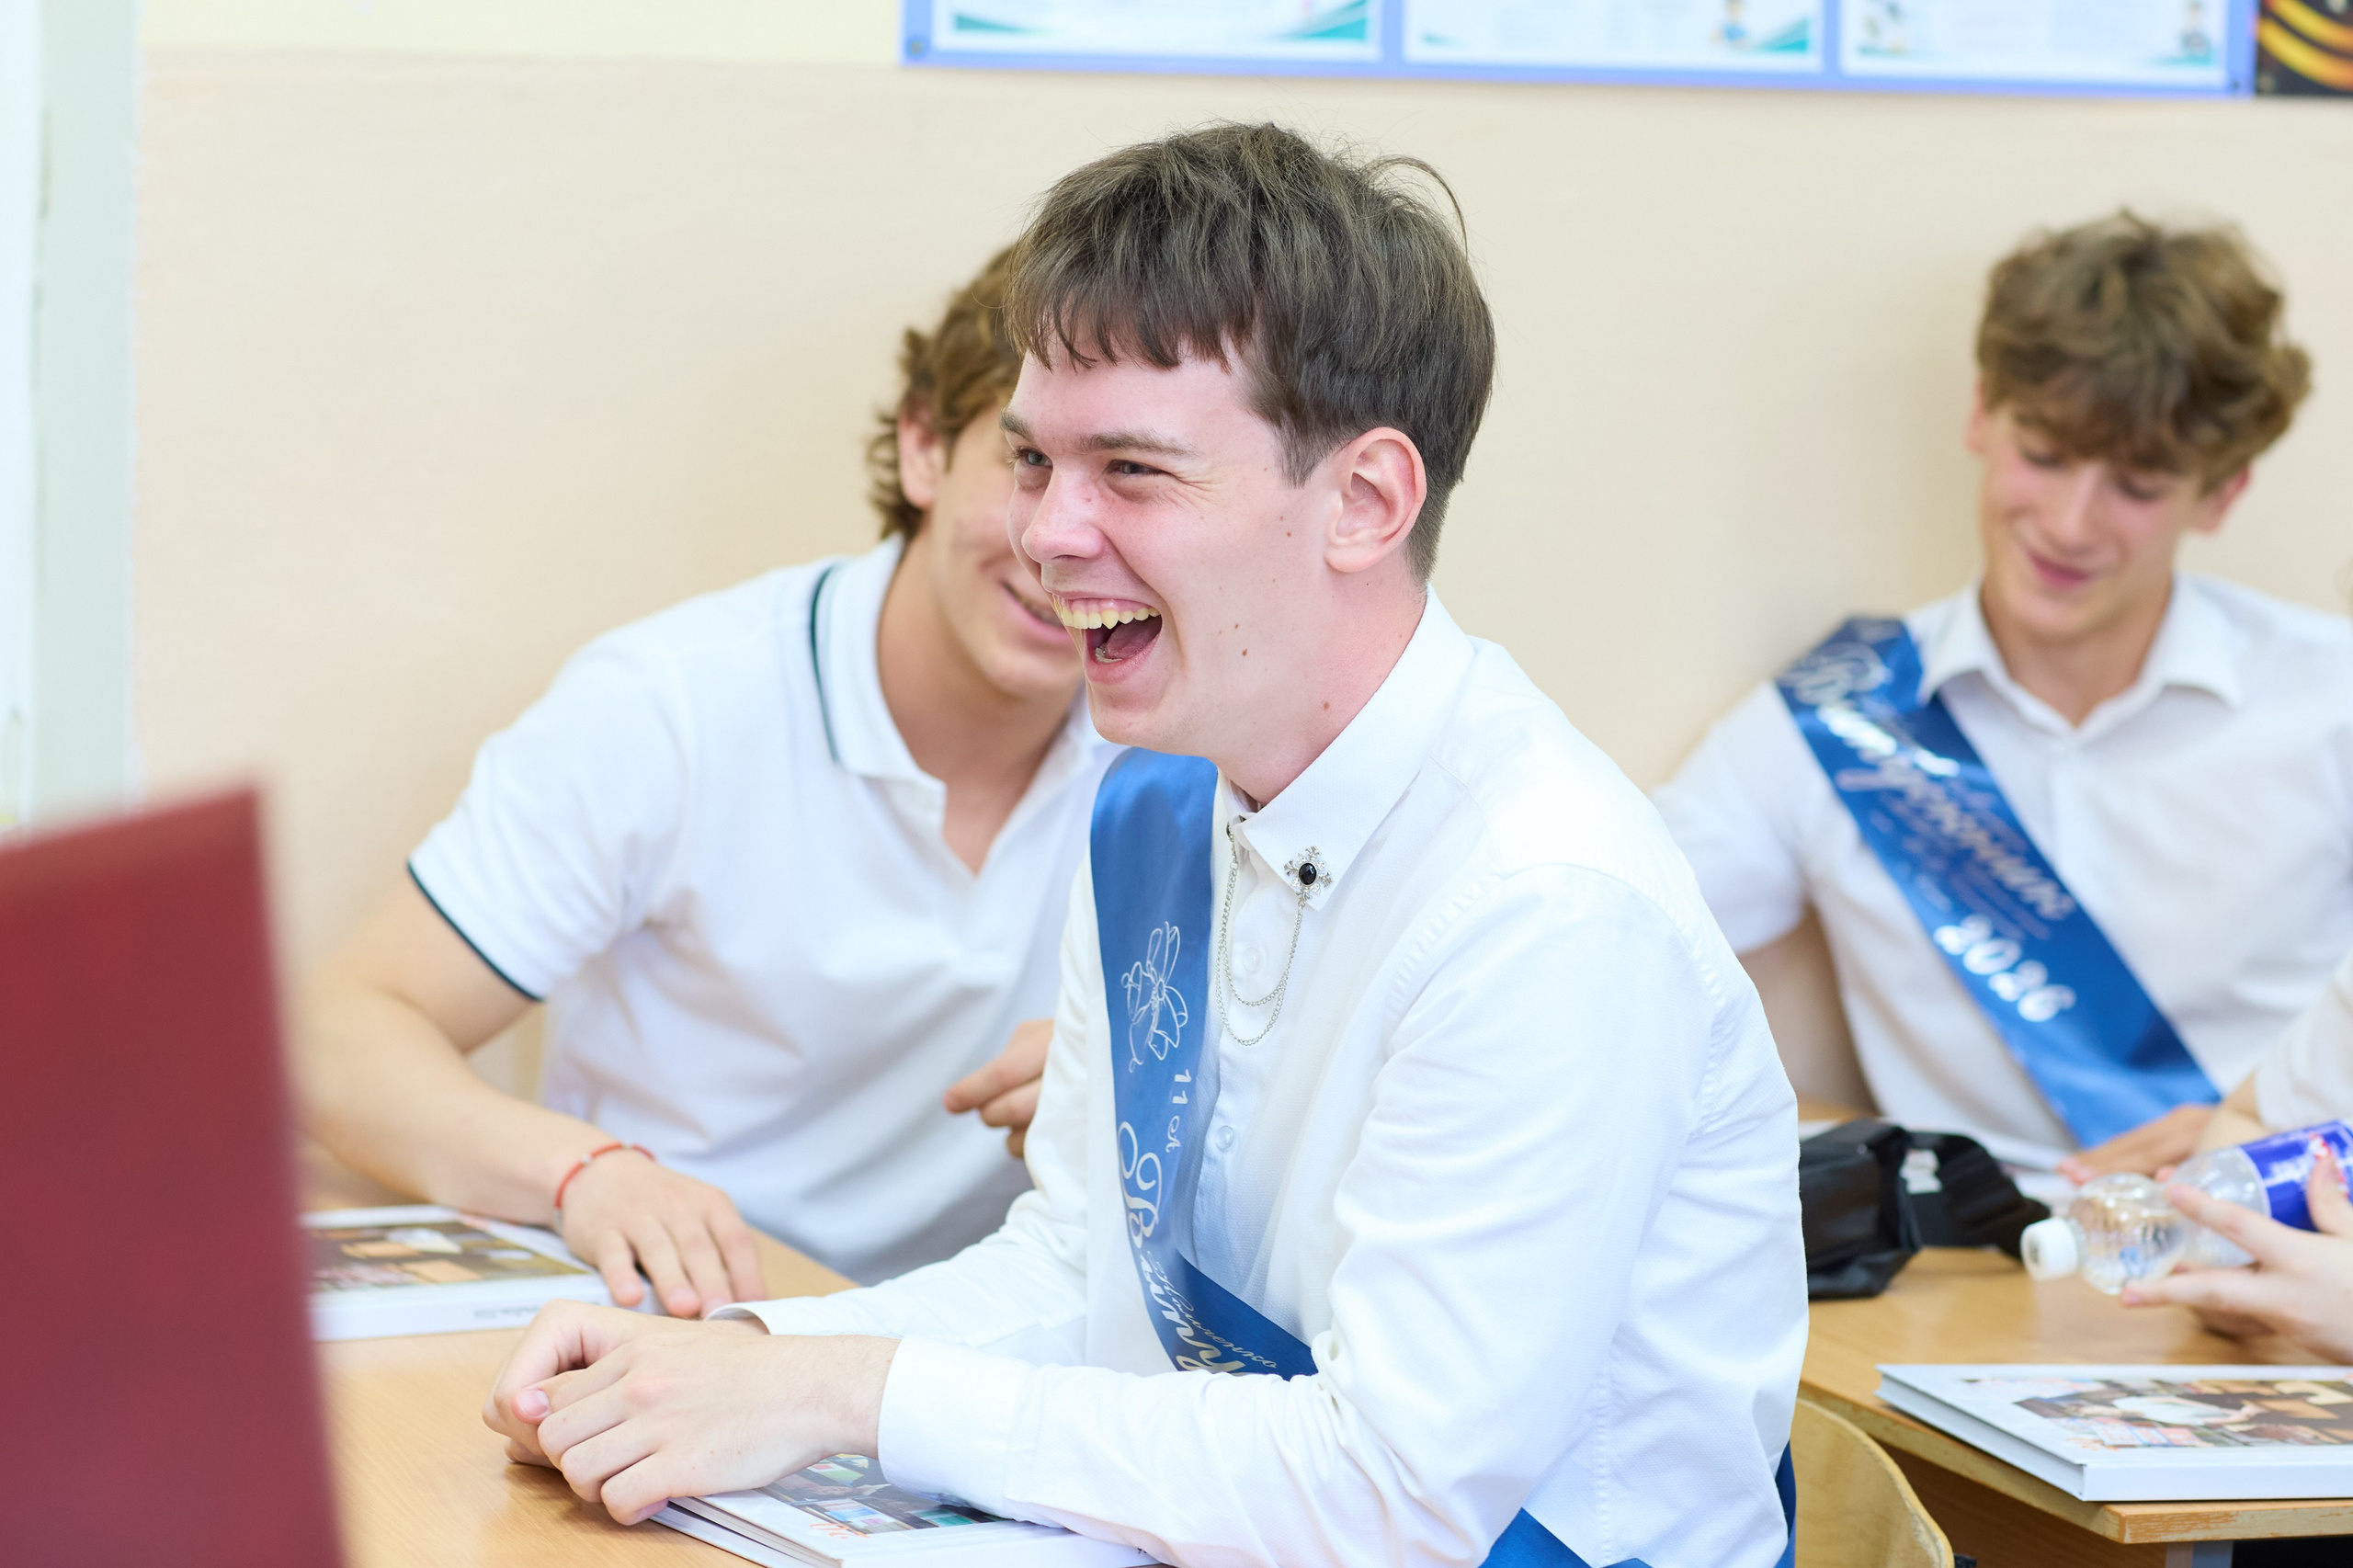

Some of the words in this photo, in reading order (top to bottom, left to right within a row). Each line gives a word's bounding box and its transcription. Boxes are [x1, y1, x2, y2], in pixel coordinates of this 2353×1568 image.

[1932, 914, 2076, 1022] 2026
[1172, 1068, 1192, 1105] 11
[1117, 1120, 1248, 1376] Выпу
